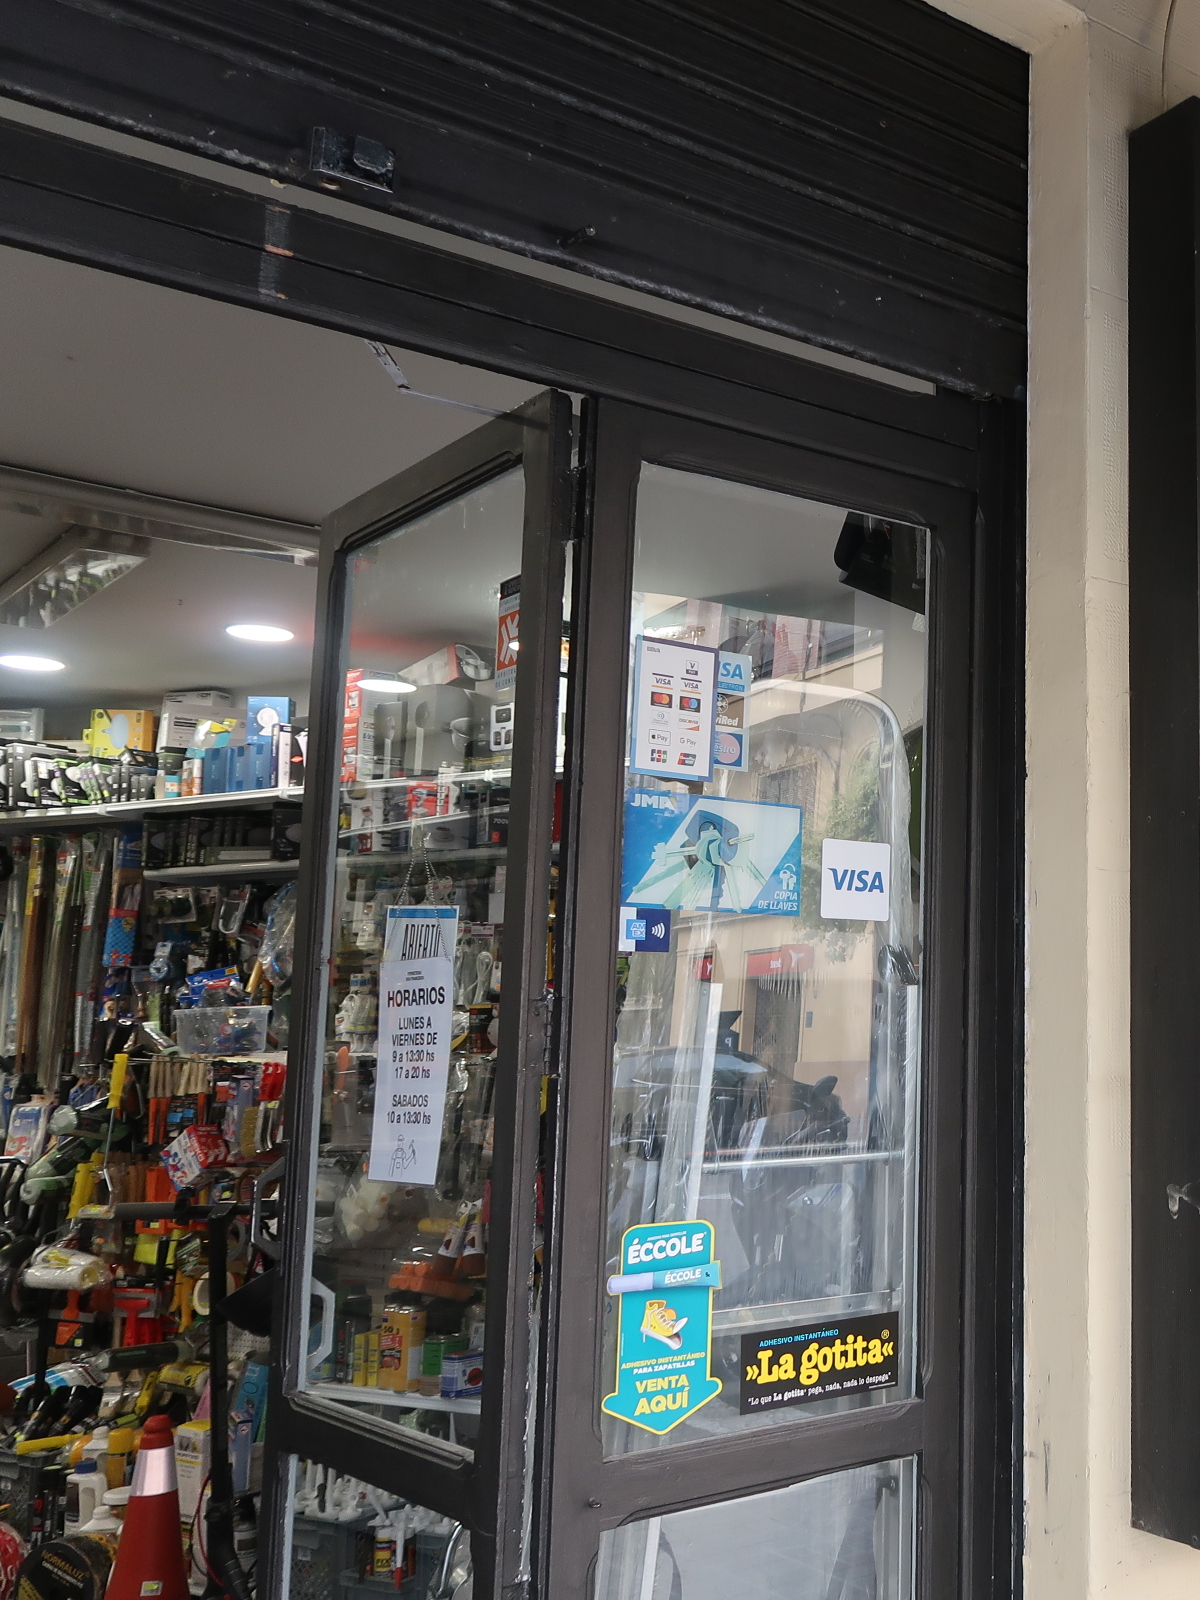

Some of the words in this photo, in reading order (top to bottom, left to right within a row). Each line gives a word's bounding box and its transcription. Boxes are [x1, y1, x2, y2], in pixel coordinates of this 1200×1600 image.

[654, 678, 672, 686] VISA
[683, 682, 699, 690] VISA
[630, 793, 676, 810] JMA
[827, 867, 884, 893] VISA
[774, 890, 798, 900] COPIA
[758, 900, 769, 909] DE
[770, 901, 798, 911] LLAVES
[387, 986, 445, 1007] HORARIOS
[399, 1017, 425, 1030] LUNES
[426, 1016, 432, 1028] A
[392, 1033, 425, 1046] VIERNES
[426, 1032, 438, 1045] DE
[392, 1051, 398, 1062] 9
[399, 1053, 404, 1062] a
[405, 1050, 424, 1062] 13:30
[426, 1050, 435, 1061] hs
[395, 1067, 403, 1078] 17
[405, 1070, 409, 1078] a
[411, 1067, 420, 1078] 20
[421, 1066, 430, 1078] hs
[392, 1095, 429, 1107] SABADOS
[387, 1111, 395, 1123] 10
[396, 1115, 401, 1123] a
[403, 1111, 421, 1124] 13:30
[423, 1111, 431, 1124] hs
[627, 1232, 705, 1265] ÉCCOLE
[664, 1269, 702, 1284] ÉCCOLE
[759, 1336, 793, 1348] ADHESIVO
[794, 1328, 839, 1342] INSTANTÁNEO
[621, 1358, 657, 1370] ADHESIVO
[658, 1351, 706, 1364] INSTANTÁNEO
[633, 1365, 653, 1375] PARA
[654, 1360, 696, 1372] ZAPATILLAS
[635, 1374, 689, 1394] VENTA
[760, 1396, 772, 1405] que
[773, 1392, 783, 1401] La
[843, 1380, 857, 1389] nada
[633, 1387, 690, 1416] AQUÍ
